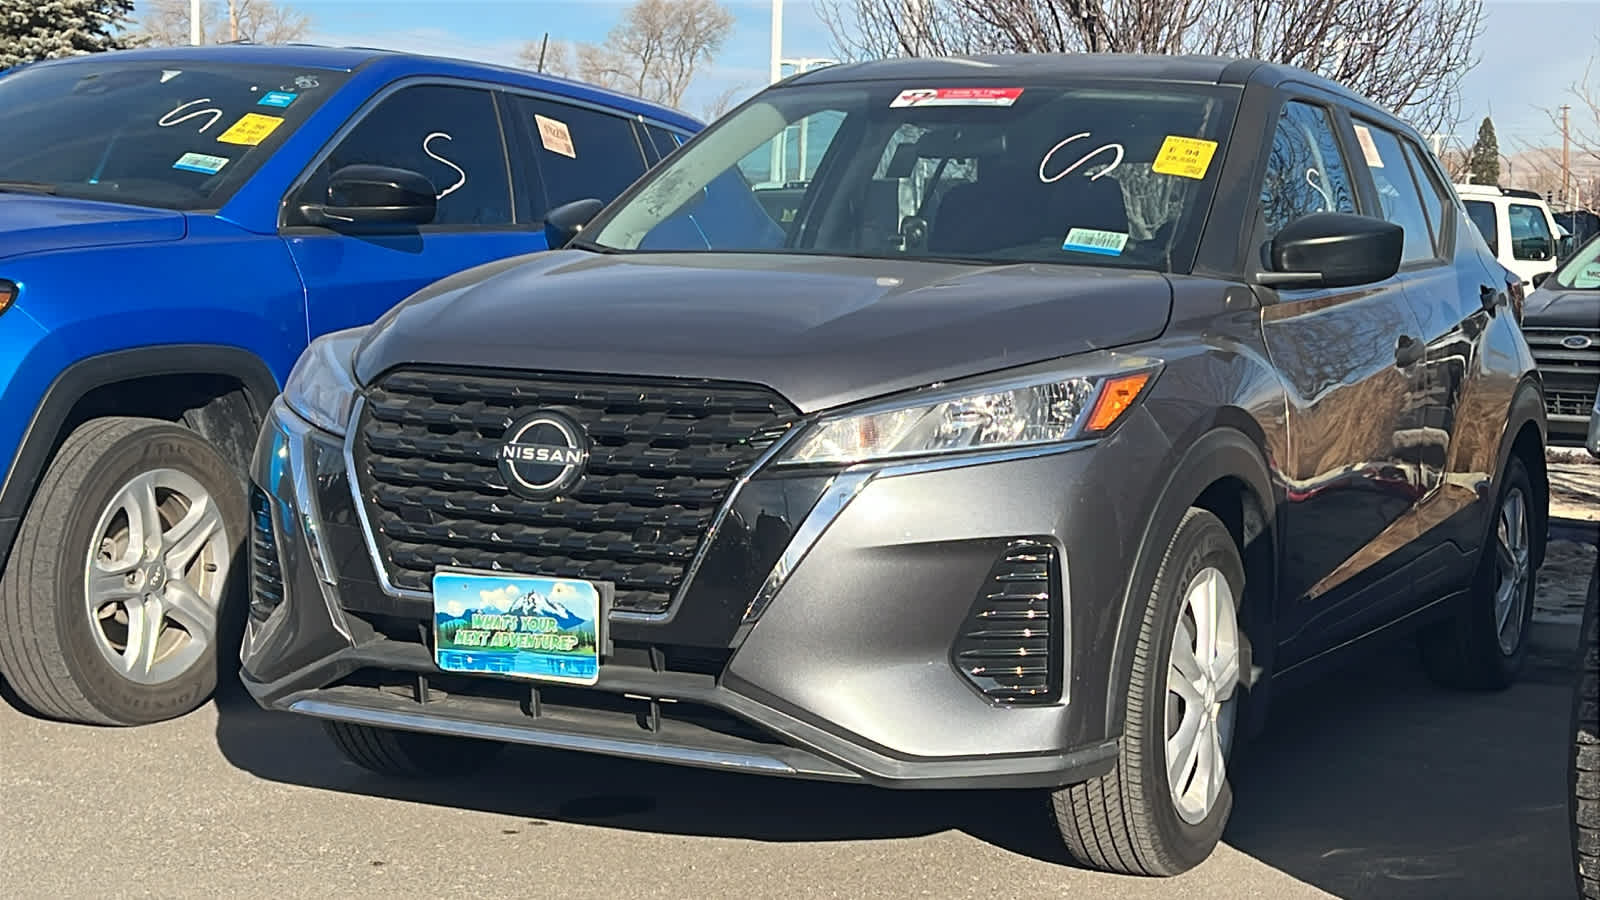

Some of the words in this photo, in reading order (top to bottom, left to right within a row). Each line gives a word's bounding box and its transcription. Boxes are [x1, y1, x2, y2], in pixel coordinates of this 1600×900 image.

[423, 132, 465, 199] S
[502, 445, 582, 463] NISSAN
[520, 615, 559, 634] YOUR
[453, 629, 490, 647] NEXT
[490, 631, 578, 652] ADVENTURE?
